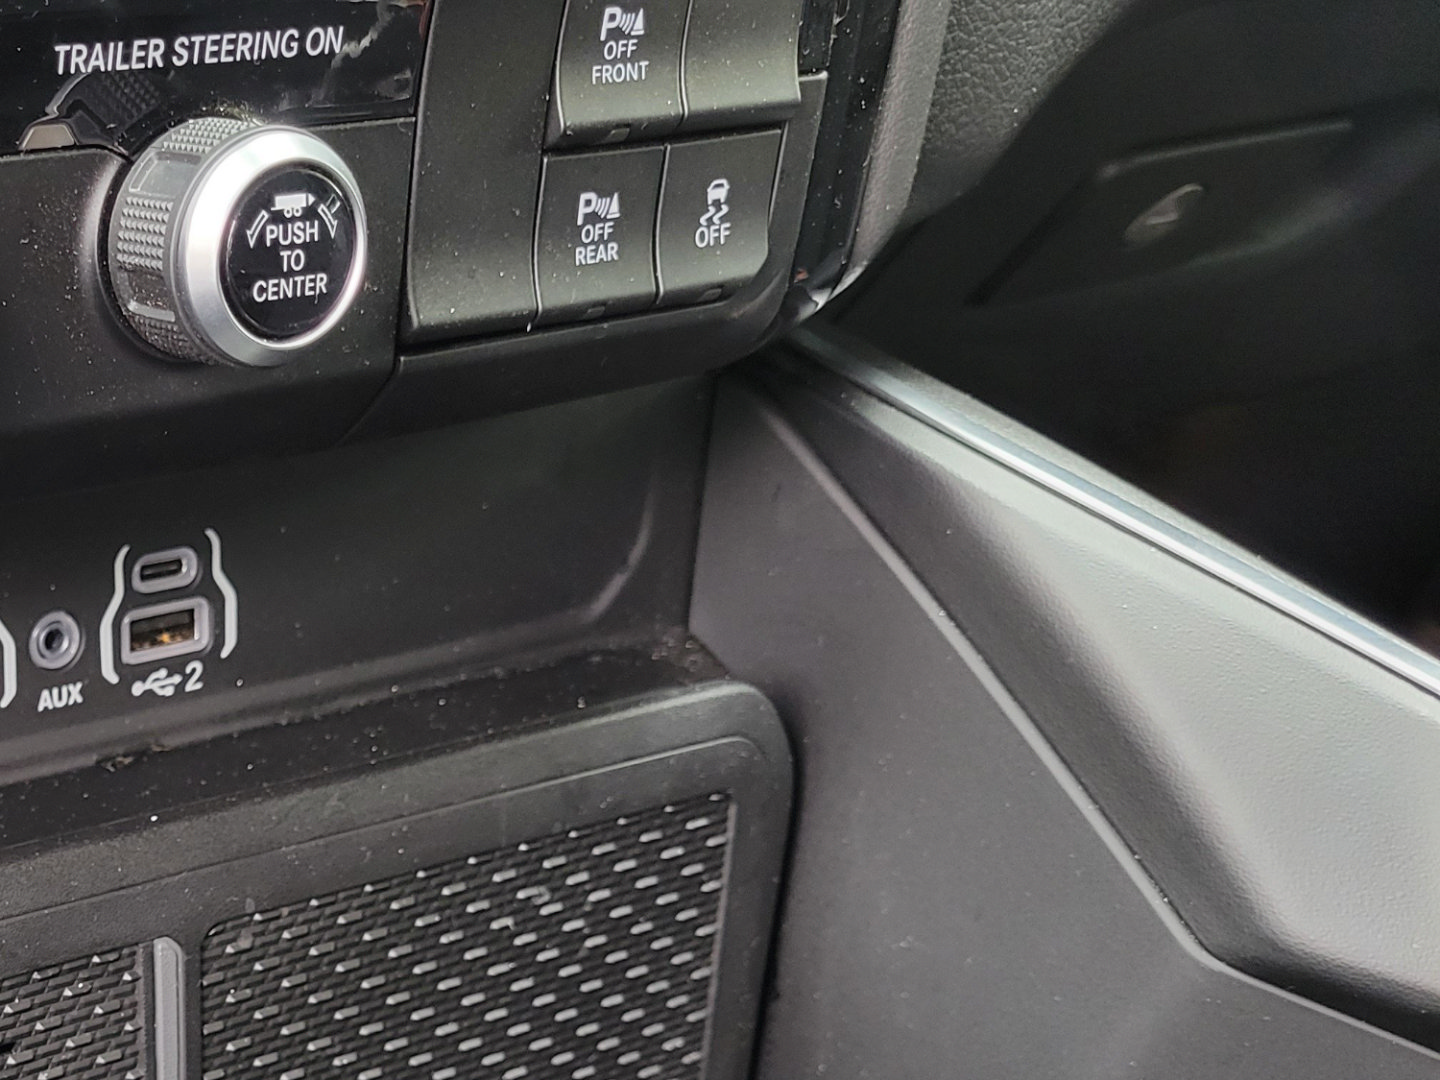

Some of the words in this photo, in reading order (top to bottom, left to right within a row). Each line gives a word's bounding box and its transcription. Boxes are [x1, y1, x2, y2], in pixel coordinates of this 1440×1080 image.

[54, 37, 165, 75] TRAILER
[172, 29, 298, 67] STEERING
[305, 25, 344, 54] ON
[603, 39, 638, 59] OFF
[592, 61, 649, 85] FRONT
[265, 220, 319, 247] PUSH
[581, 222, 614, 243] OFF
[695, 223, 731, 249] OFF
[280, 249, 305, 273] TO
[575, 242, 619, 266] REAR
[252, 274, 328, 303] CENTER
[184, 660, 204, 693] 2
[37, 682, 84, 712] AUX
